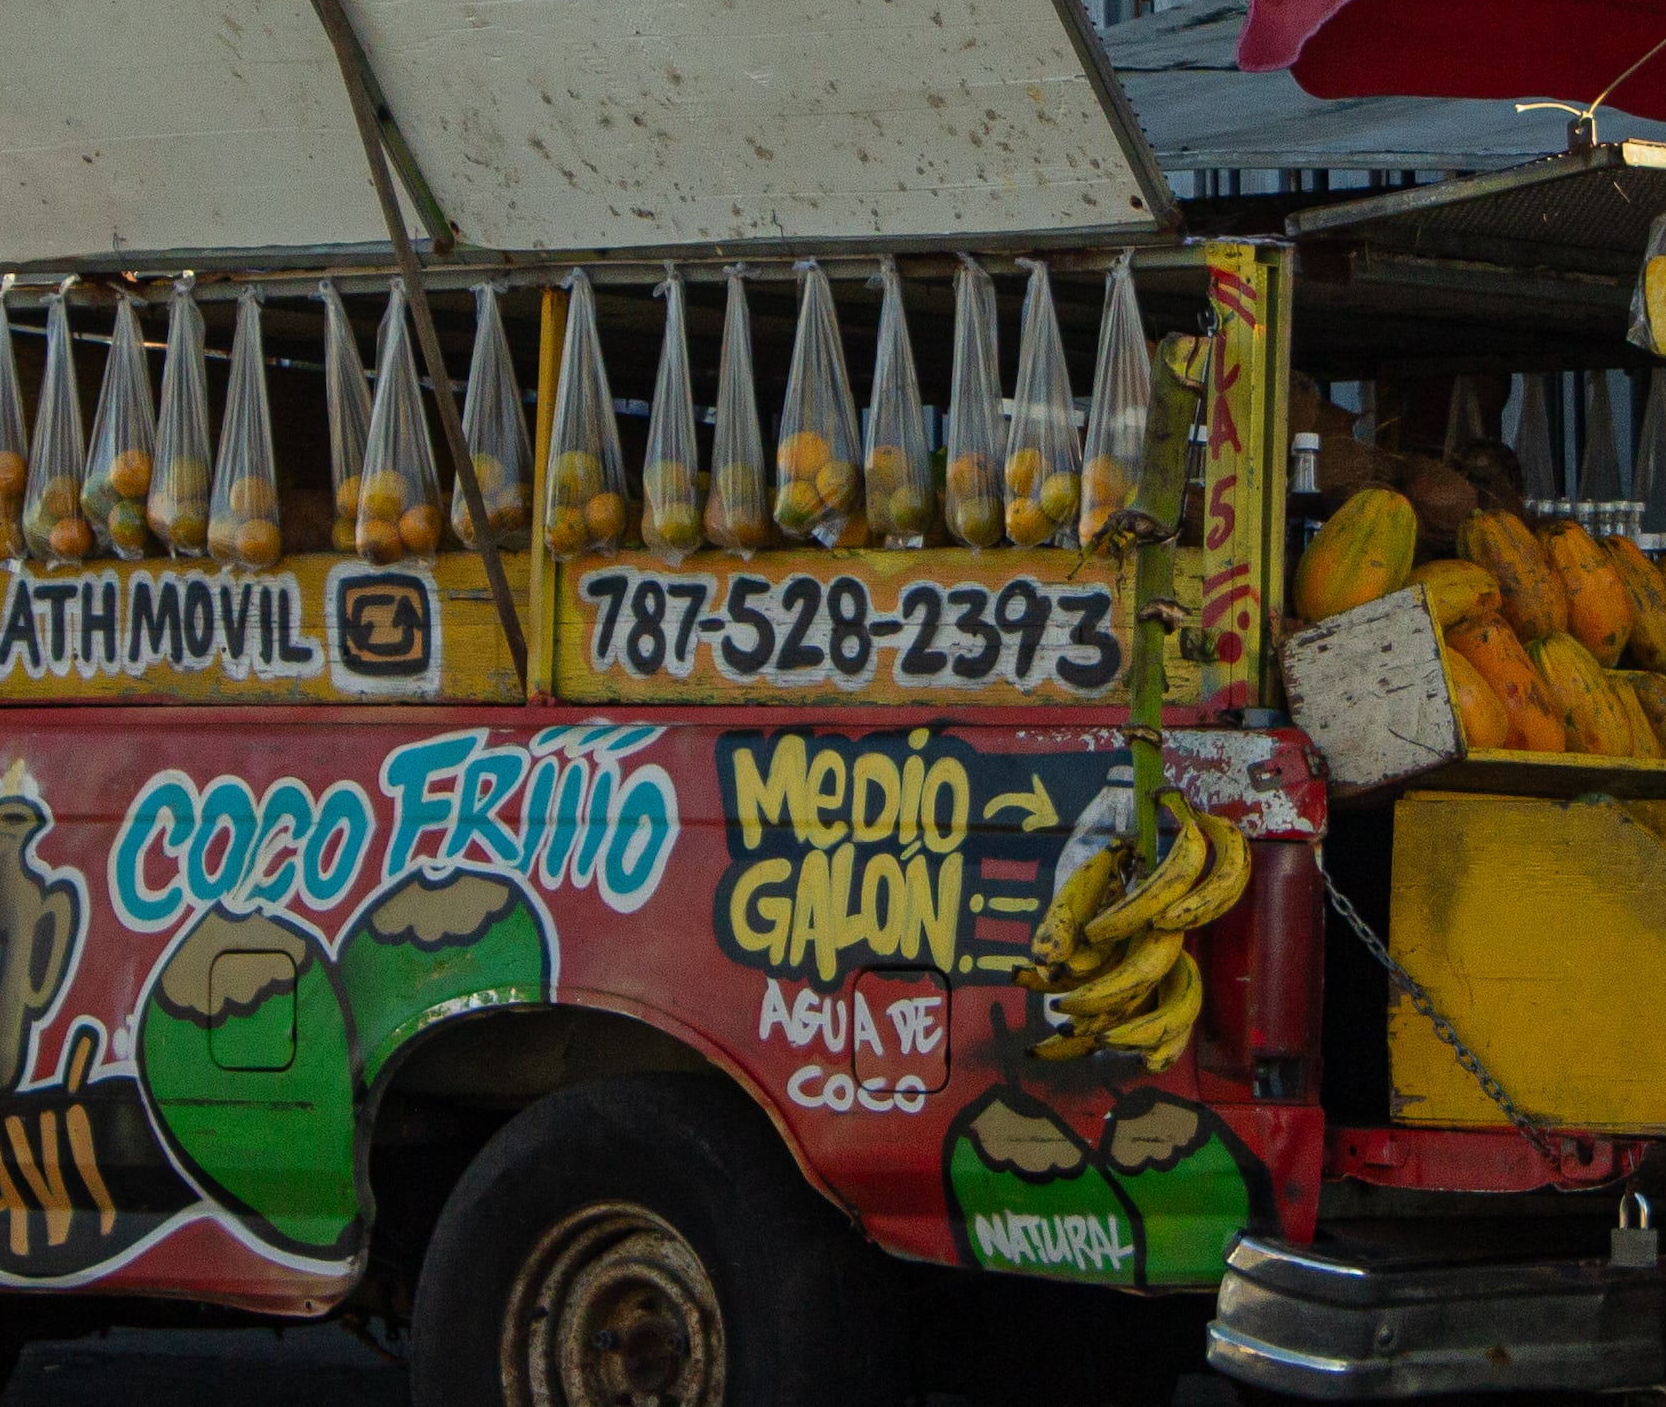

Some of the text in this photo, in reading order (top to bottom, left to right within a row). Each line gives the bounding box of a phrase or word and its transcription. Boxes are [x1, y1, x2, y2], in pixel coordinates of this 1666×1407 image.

[125, 573, 321, 677] MOVIL
[583, 572, 1123, 692] 787-528-2393
[108, 768, 375, 931] COCO
[759, 977, 943, 1056] AGUA DE
[787, 1065, 926, 1113] COCO
[975, 1209, 1134, 1271] NATURAL
